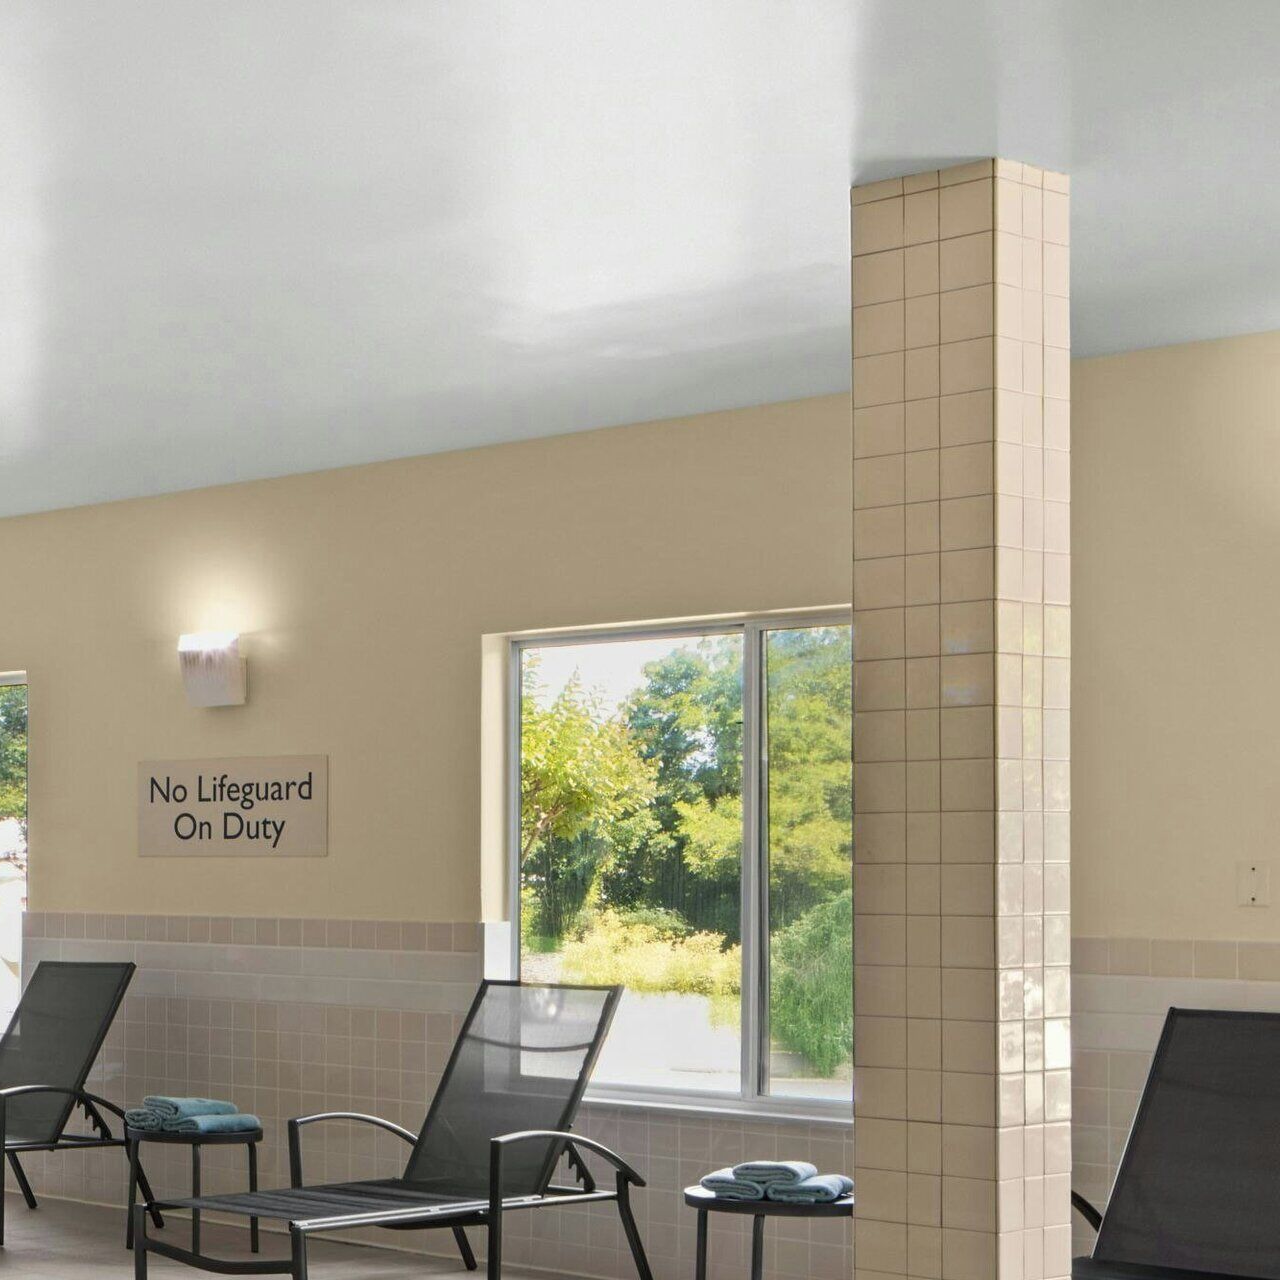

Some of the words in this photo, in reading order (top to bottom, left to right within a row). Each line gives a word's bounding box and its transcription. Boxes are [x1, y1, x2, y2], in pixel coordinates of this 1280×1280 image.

[150, 776, 188, 803] No
[198, 771, 312, 810] Lifeguard
[174, 812, 212, 840] On
[223, 812, 286, 848] Duty
